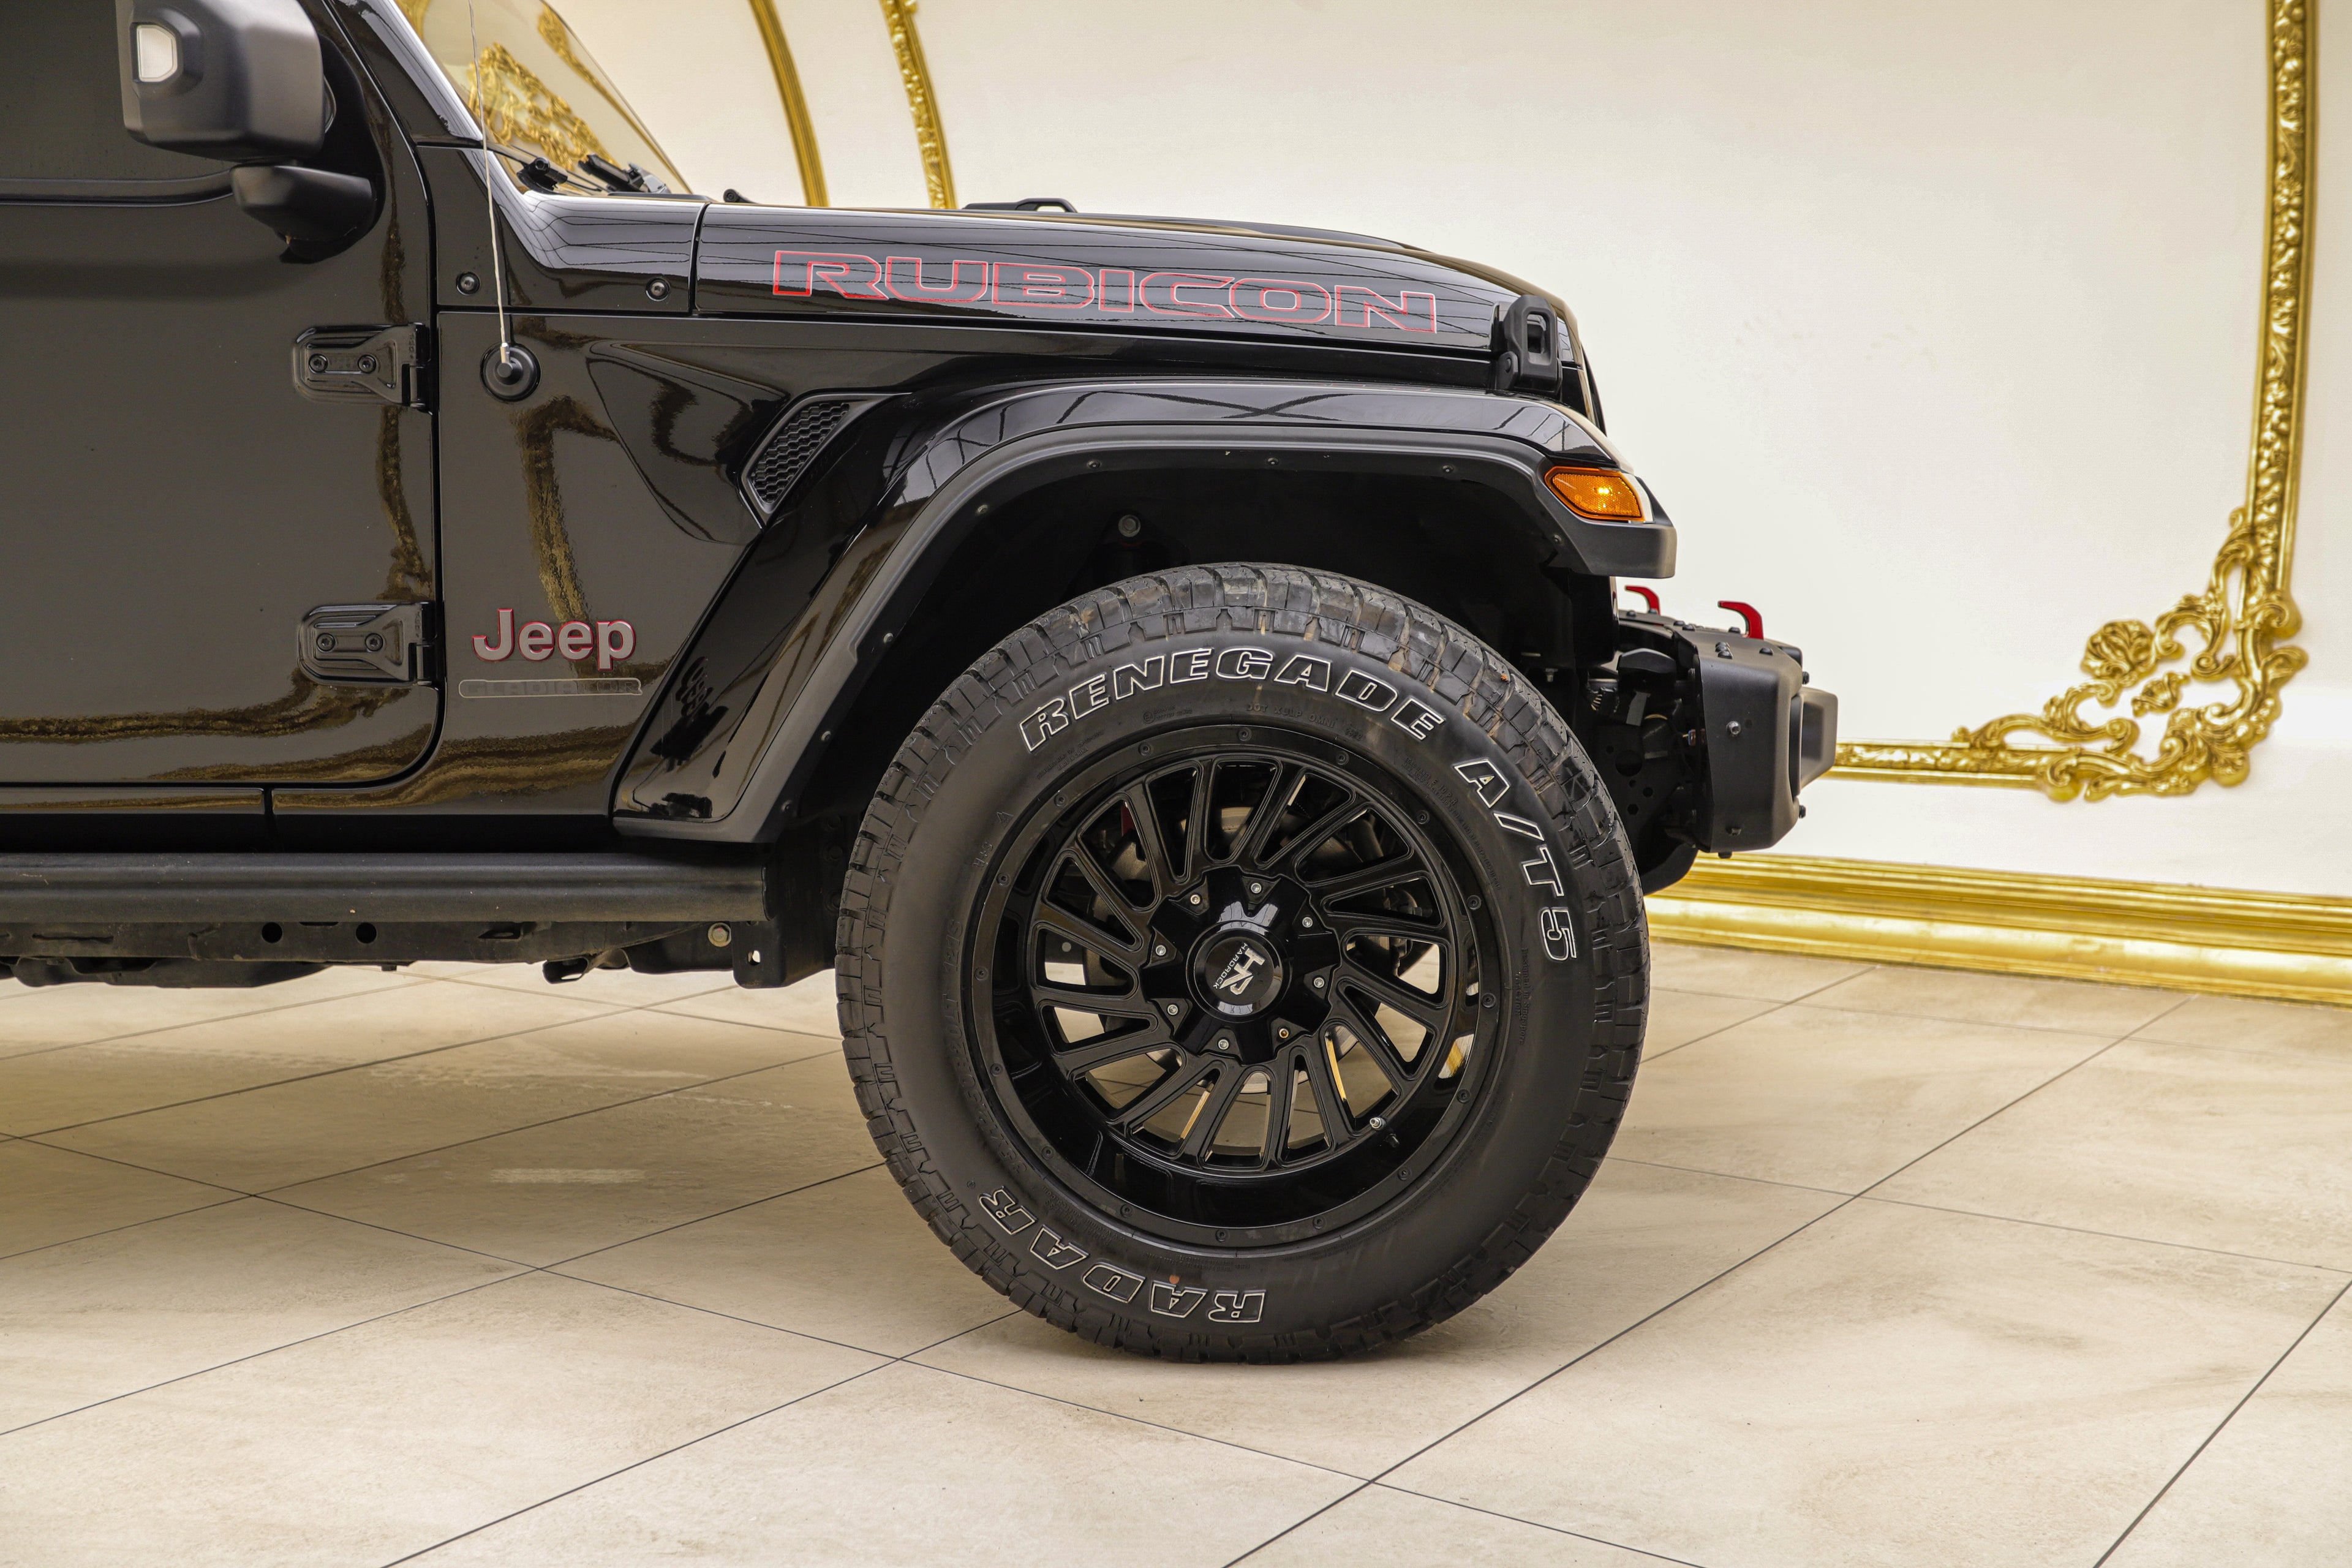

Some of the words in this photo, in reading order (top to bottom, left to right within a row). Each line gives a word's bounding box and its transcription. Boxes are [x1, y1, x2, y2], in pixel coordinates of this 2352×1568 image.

[773, 250, 1437, 333] RUBICON
[472, 608, 636, 671] Jeep
[459, 678, 642, 698] GLADIATOR
[1018, 647, 1444, 753] RENEGADE
[1453, 758, 1577, 961] A/T5
[1213, 943, 1248, 989] HARDROCK
[979, 1186, 1268, 1324] RADAR
